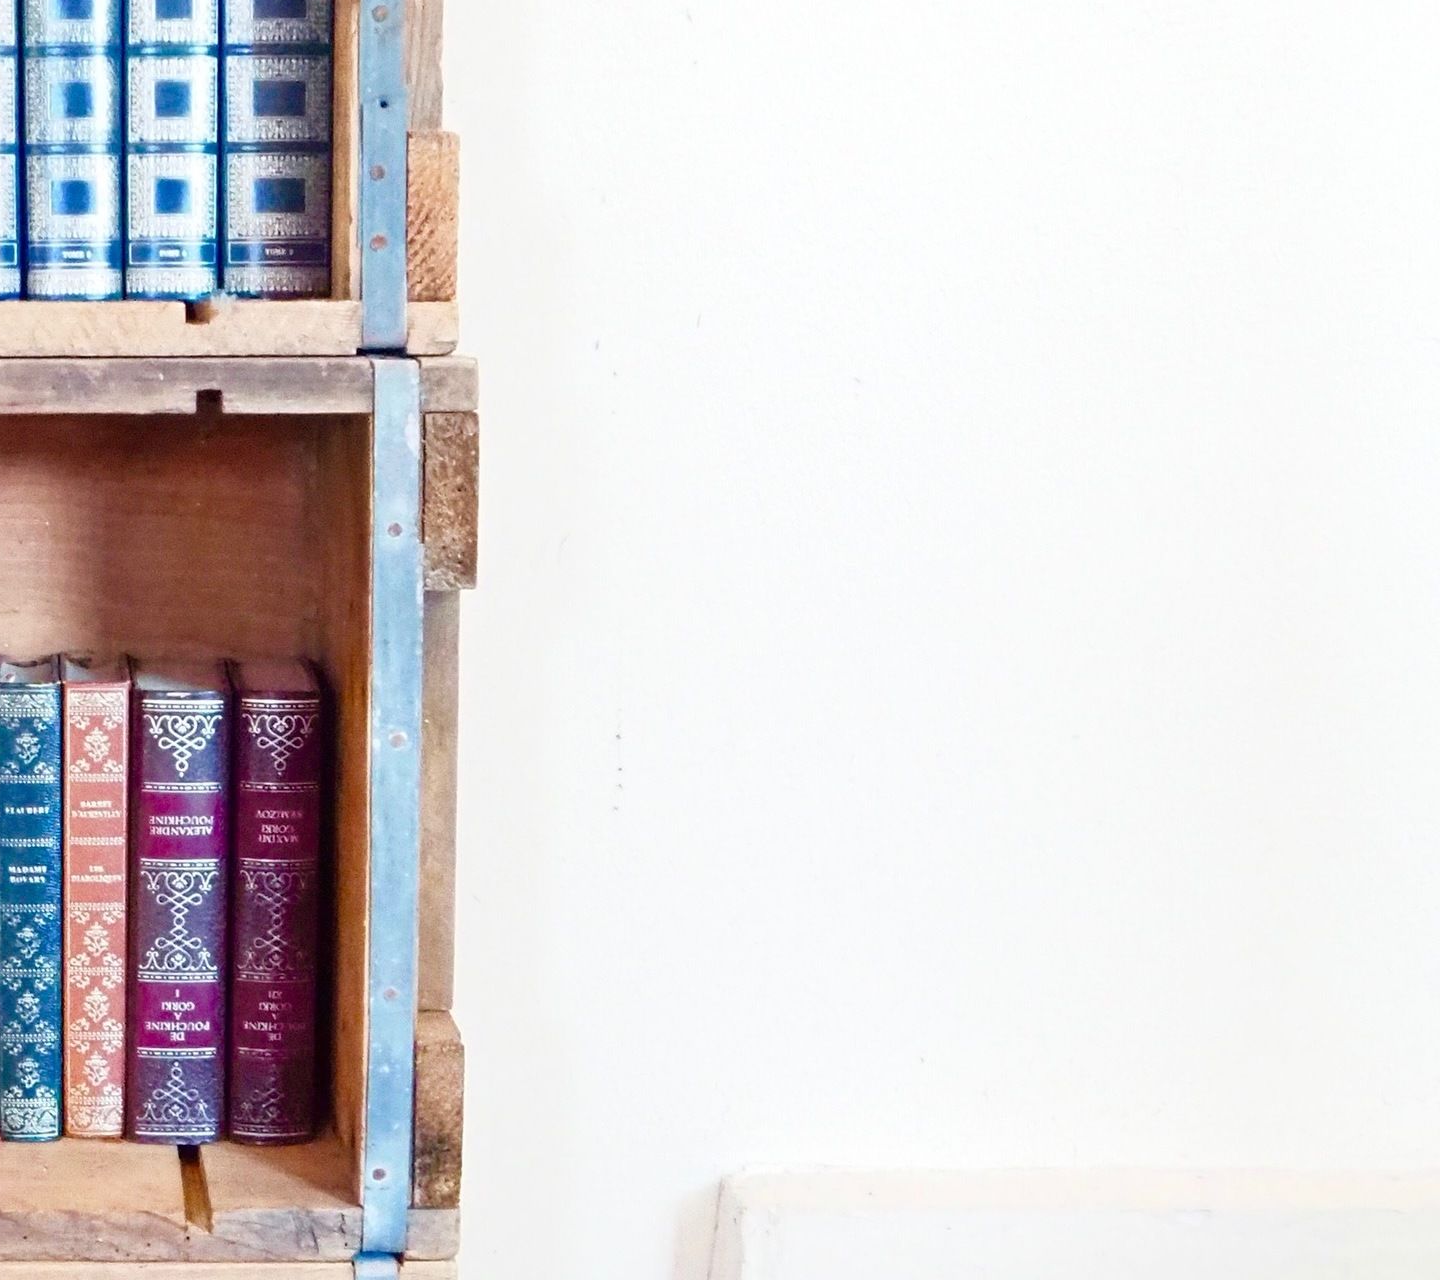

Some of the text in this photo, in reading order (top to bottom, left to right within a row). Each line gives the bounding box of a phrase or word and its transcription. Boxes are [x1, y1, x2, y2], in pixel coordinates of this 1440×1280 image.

[149, 815, 214, 825] POUCHKINE
[150, 825, 213, 836] ALEXANDRE
[8, 866, 48, 874] MADAME
[161, 1001, 195, 1011] GORKI
[145, 1020, 210, 1031] POUCHKINE
[170, 1031, 185, 1041] DE
